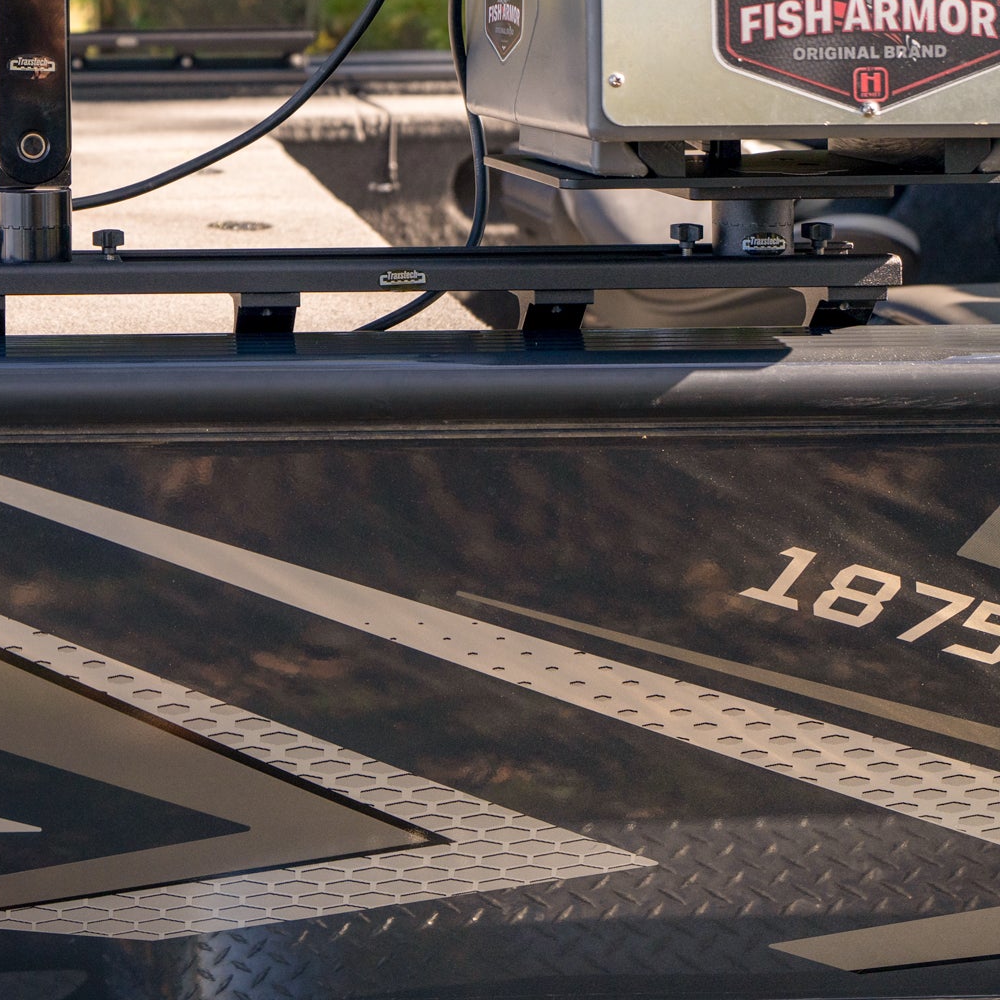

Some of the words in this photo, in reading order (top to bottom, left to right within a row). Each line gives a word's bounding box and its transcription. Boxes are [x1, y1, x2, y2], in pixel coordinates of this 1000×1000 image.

[489, 4, 501, 24] FISH
[793, 46, 879, 60] ORIGINAL
[884, 45, 947, 60] BRAND
[738, 546, 1000, 665] 1875
